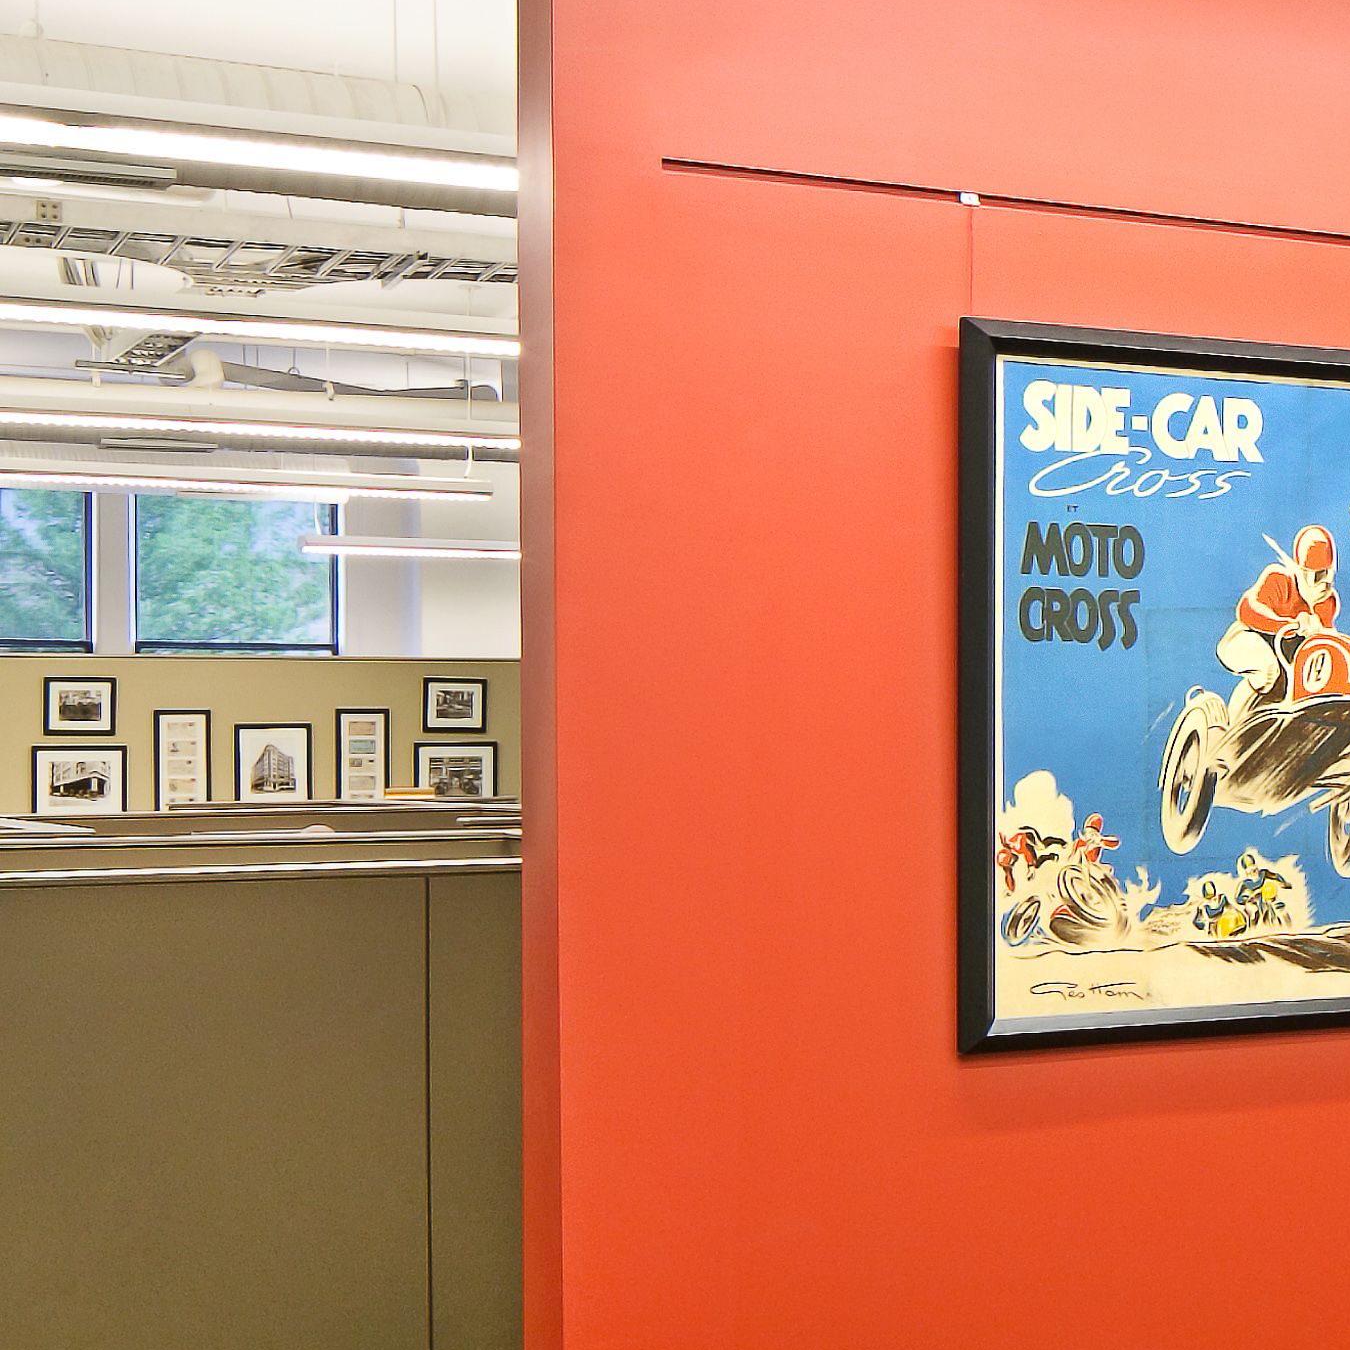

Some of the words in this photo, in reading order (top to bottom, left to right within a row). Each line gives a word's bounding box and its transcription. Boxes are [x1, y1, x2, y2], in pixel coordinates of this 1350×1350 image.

[1020, 379, 1264, 463] SIDE-CAR
[1029, 446, 1251, 499] Cross
[1021, 521, 1145, 579] MOTO
[1019, 587, 1140, 651] CROSS
